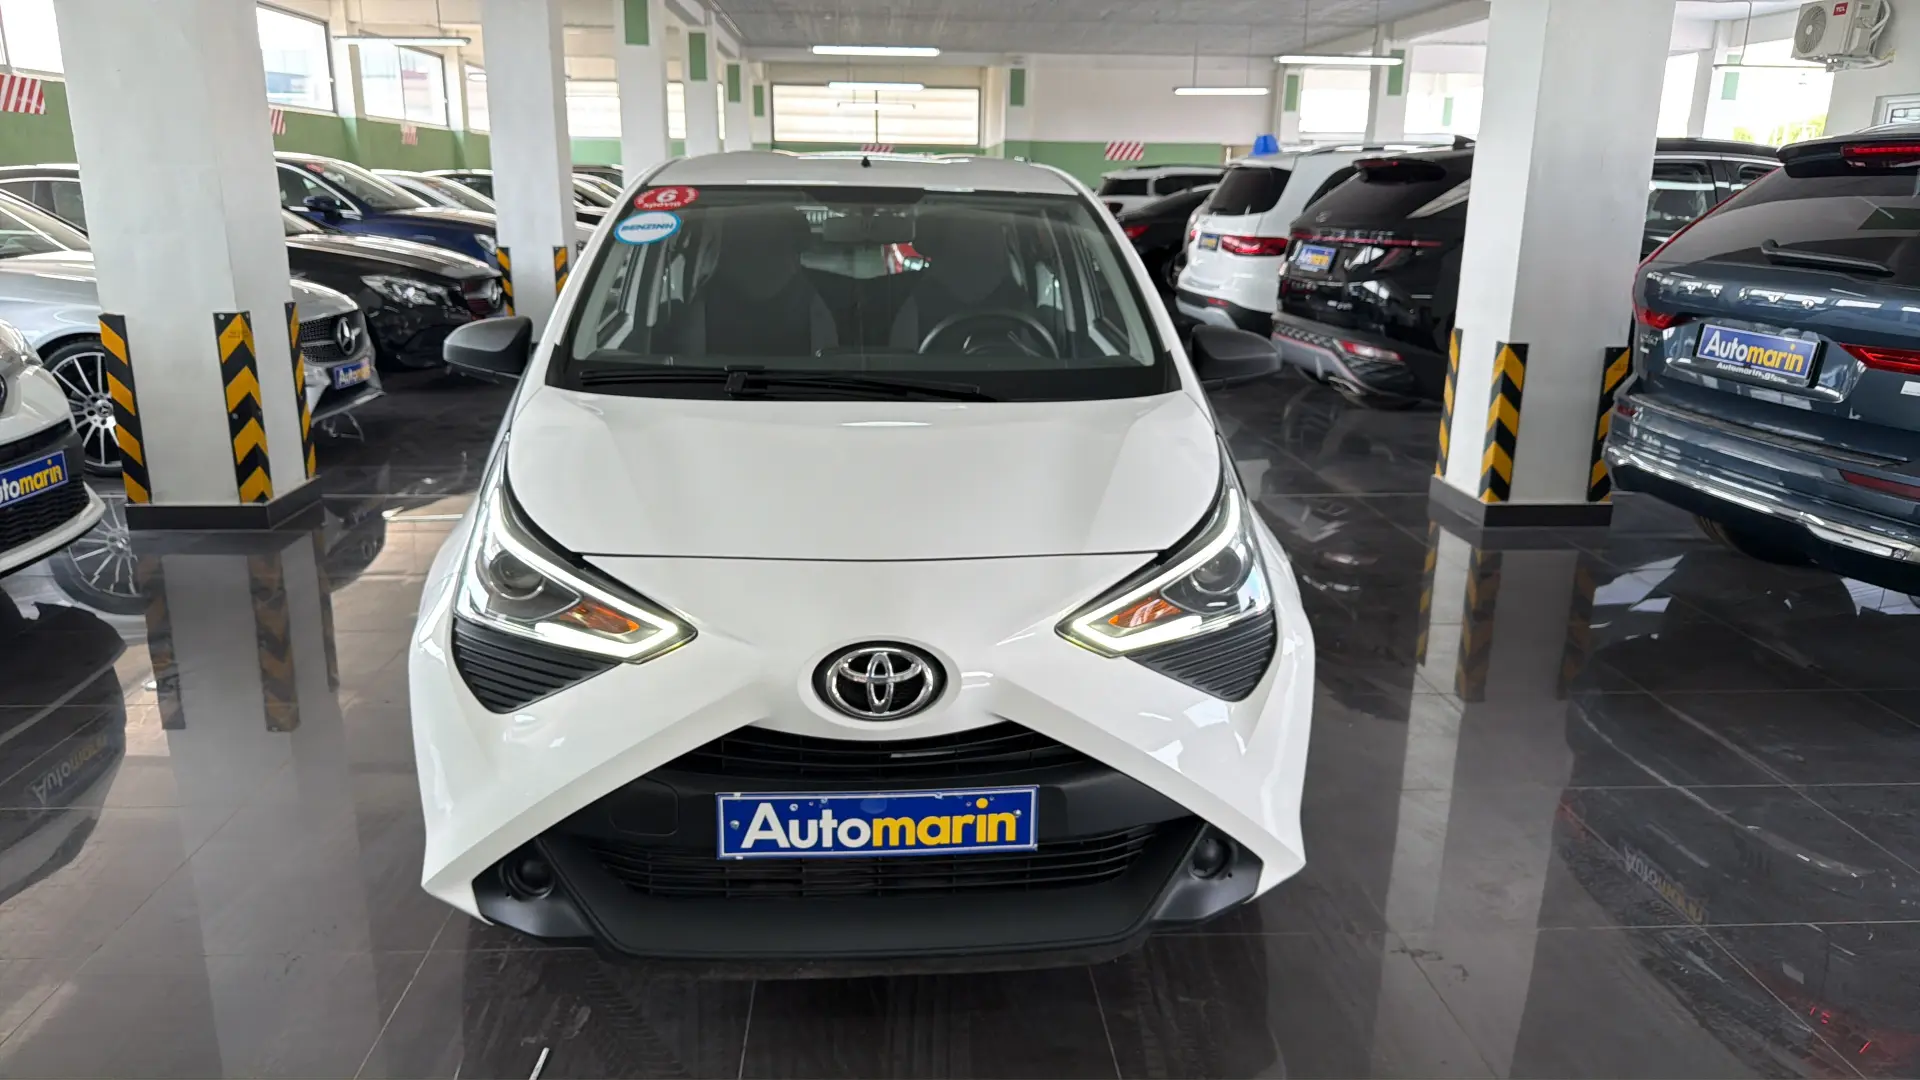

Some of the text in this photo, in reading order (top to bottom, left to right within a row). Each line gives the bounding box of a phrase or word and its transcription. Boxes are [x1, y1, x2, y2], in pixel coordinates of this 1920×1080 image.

[656, 189, 678, 202] 6
[1703, 329, 1804, 373] Automarin
[740, 797, 1017, 849] Automarin
